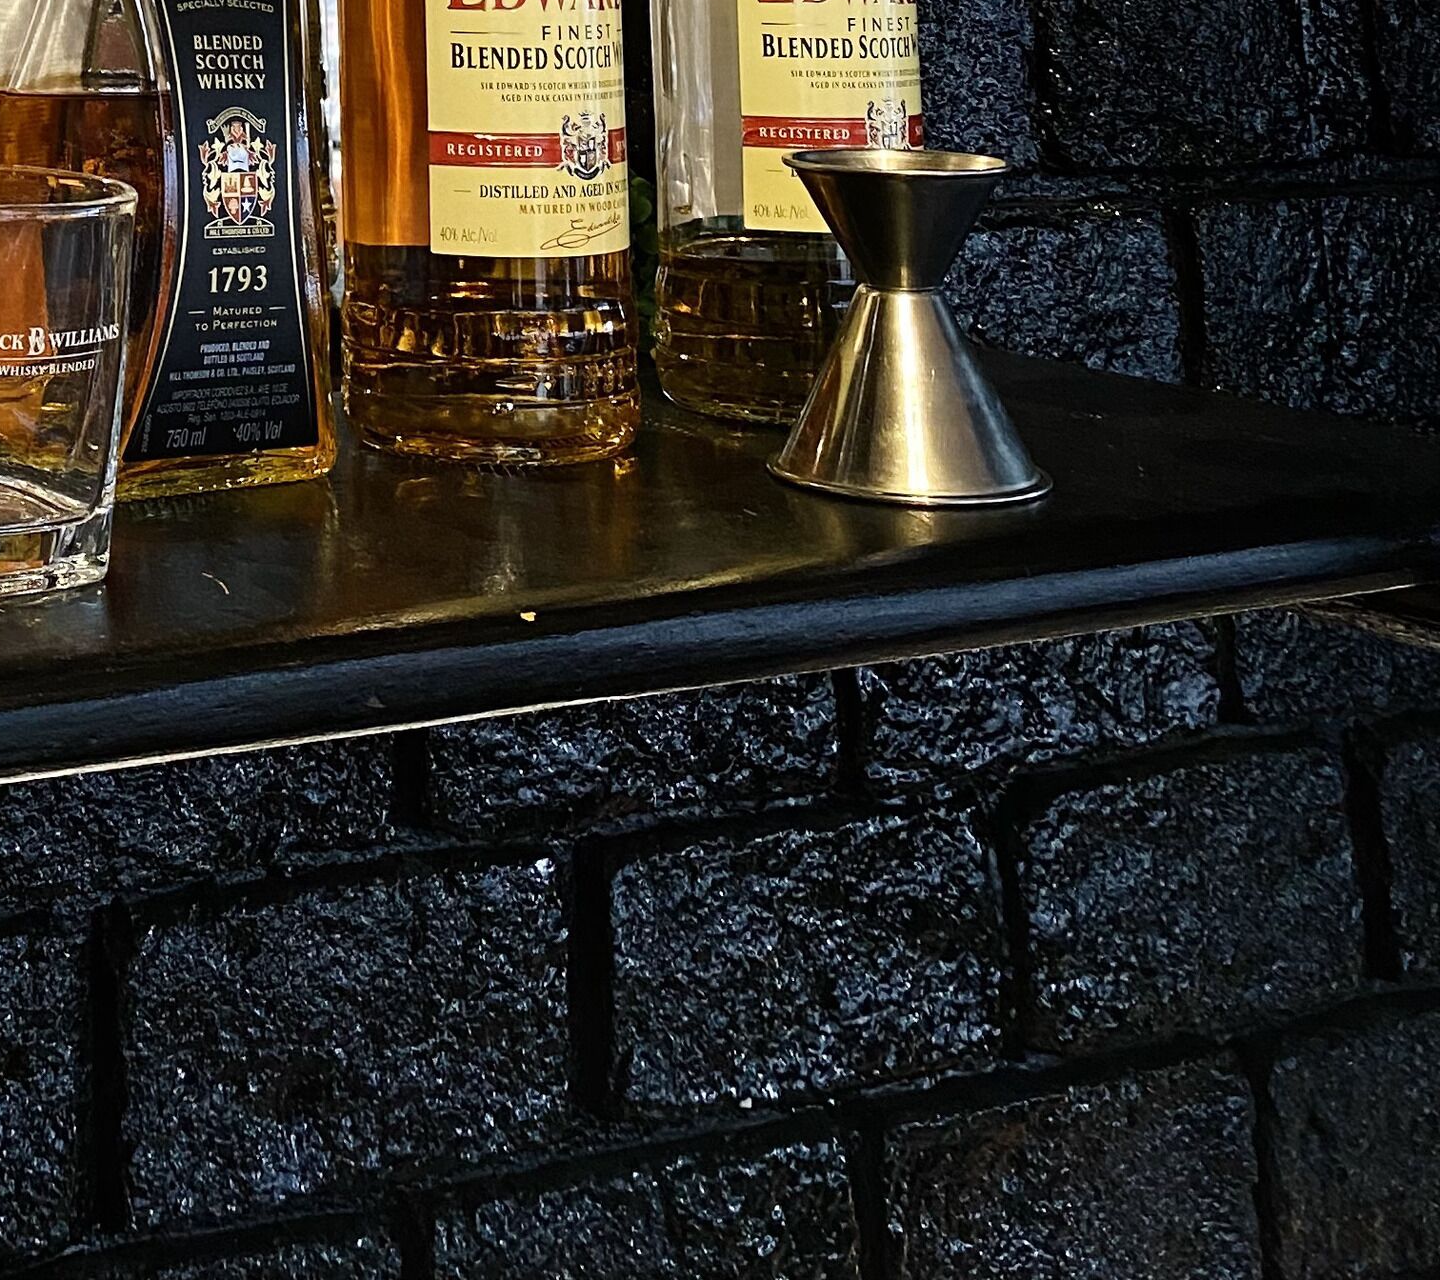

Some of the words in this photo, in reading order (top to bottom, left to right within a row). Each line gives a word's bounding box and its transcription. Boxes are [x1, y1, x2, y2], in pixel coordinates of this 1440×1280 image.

[227, 0, 274, 13] SELECTED
[542, 24, 610, 40] FINEST
[847, 17, 909, 32] FINEST
[194, 35, 262, 50] BLENDED
[762, 34, 852, 59] BLENDED
[859, 35, 910, 59] SCOTCH
[196, 54, 264, 70] SCOTCH
[451, 42, 548, 70] BLENDED
[554, 44, 611, 70] SCOTCH
[197, 73, 266, 89] WHISKY
[480, 82, 494, 90] SIR
[501, 94, 521, 102] AGED
[759, 126, 850, 140] REGISTERED
[447, 142, 543, 157] REGISTERED
[480, 185, 548, 199] DISTILLED
[553, 185, 576, 198] AND
[579, 183, 604, 197] AGED
[520, 204, 572, 215] MATURED
[576, 203, 586, 213] IN
[589, 200, 612, 211] WOOD
[212, 246, 266, 255] ESTABLISHED
[209, 265, 268, 293] 1793
[213, 306, 262, 316] MATURED
[212, 319, 277, 331] PERFECTION
[49, 322, 120, 349] WILLIAMS
[166, 430, 191, 448] 750
[192, 427, 207, 446] ml
[236, 422, 261, 441] 40%
[265, 420, 282, 439] Vol
